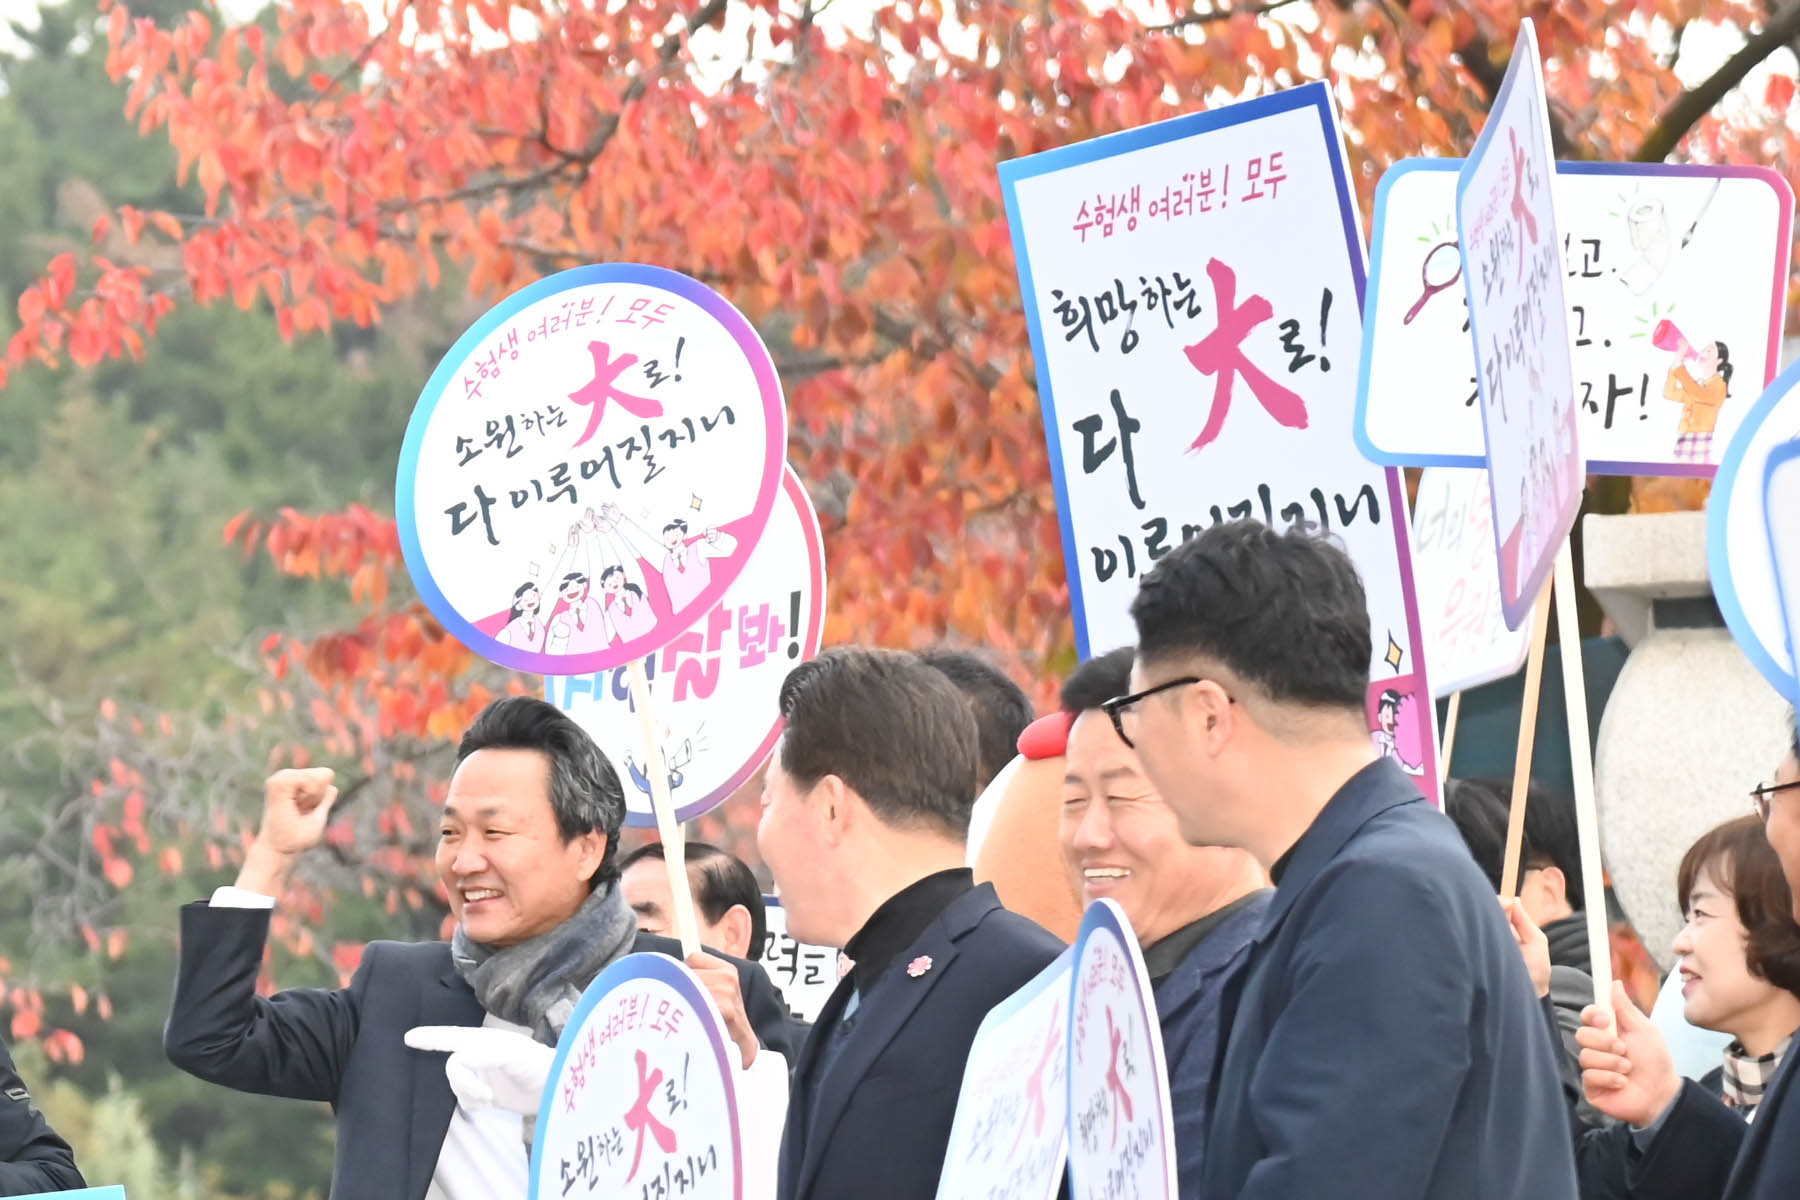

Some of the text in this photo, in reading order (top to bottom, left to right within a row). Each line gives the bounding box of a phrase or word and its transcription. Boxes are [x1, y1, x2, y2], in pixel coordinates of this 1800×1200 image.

[1073, 151, 1288, 243] 수험생 여러분! 모두
[464, 295, 676, 400] 수험생 여러분! 모두
[1051, 272, 1201, 354] 희망하는
[455, 404, 568, 467] 소원하는
[1072, 388, 1146, 510] 다
[650, 1000, 685, 1040] 모두
[561, 1126, 623, 1197] 소원하는
